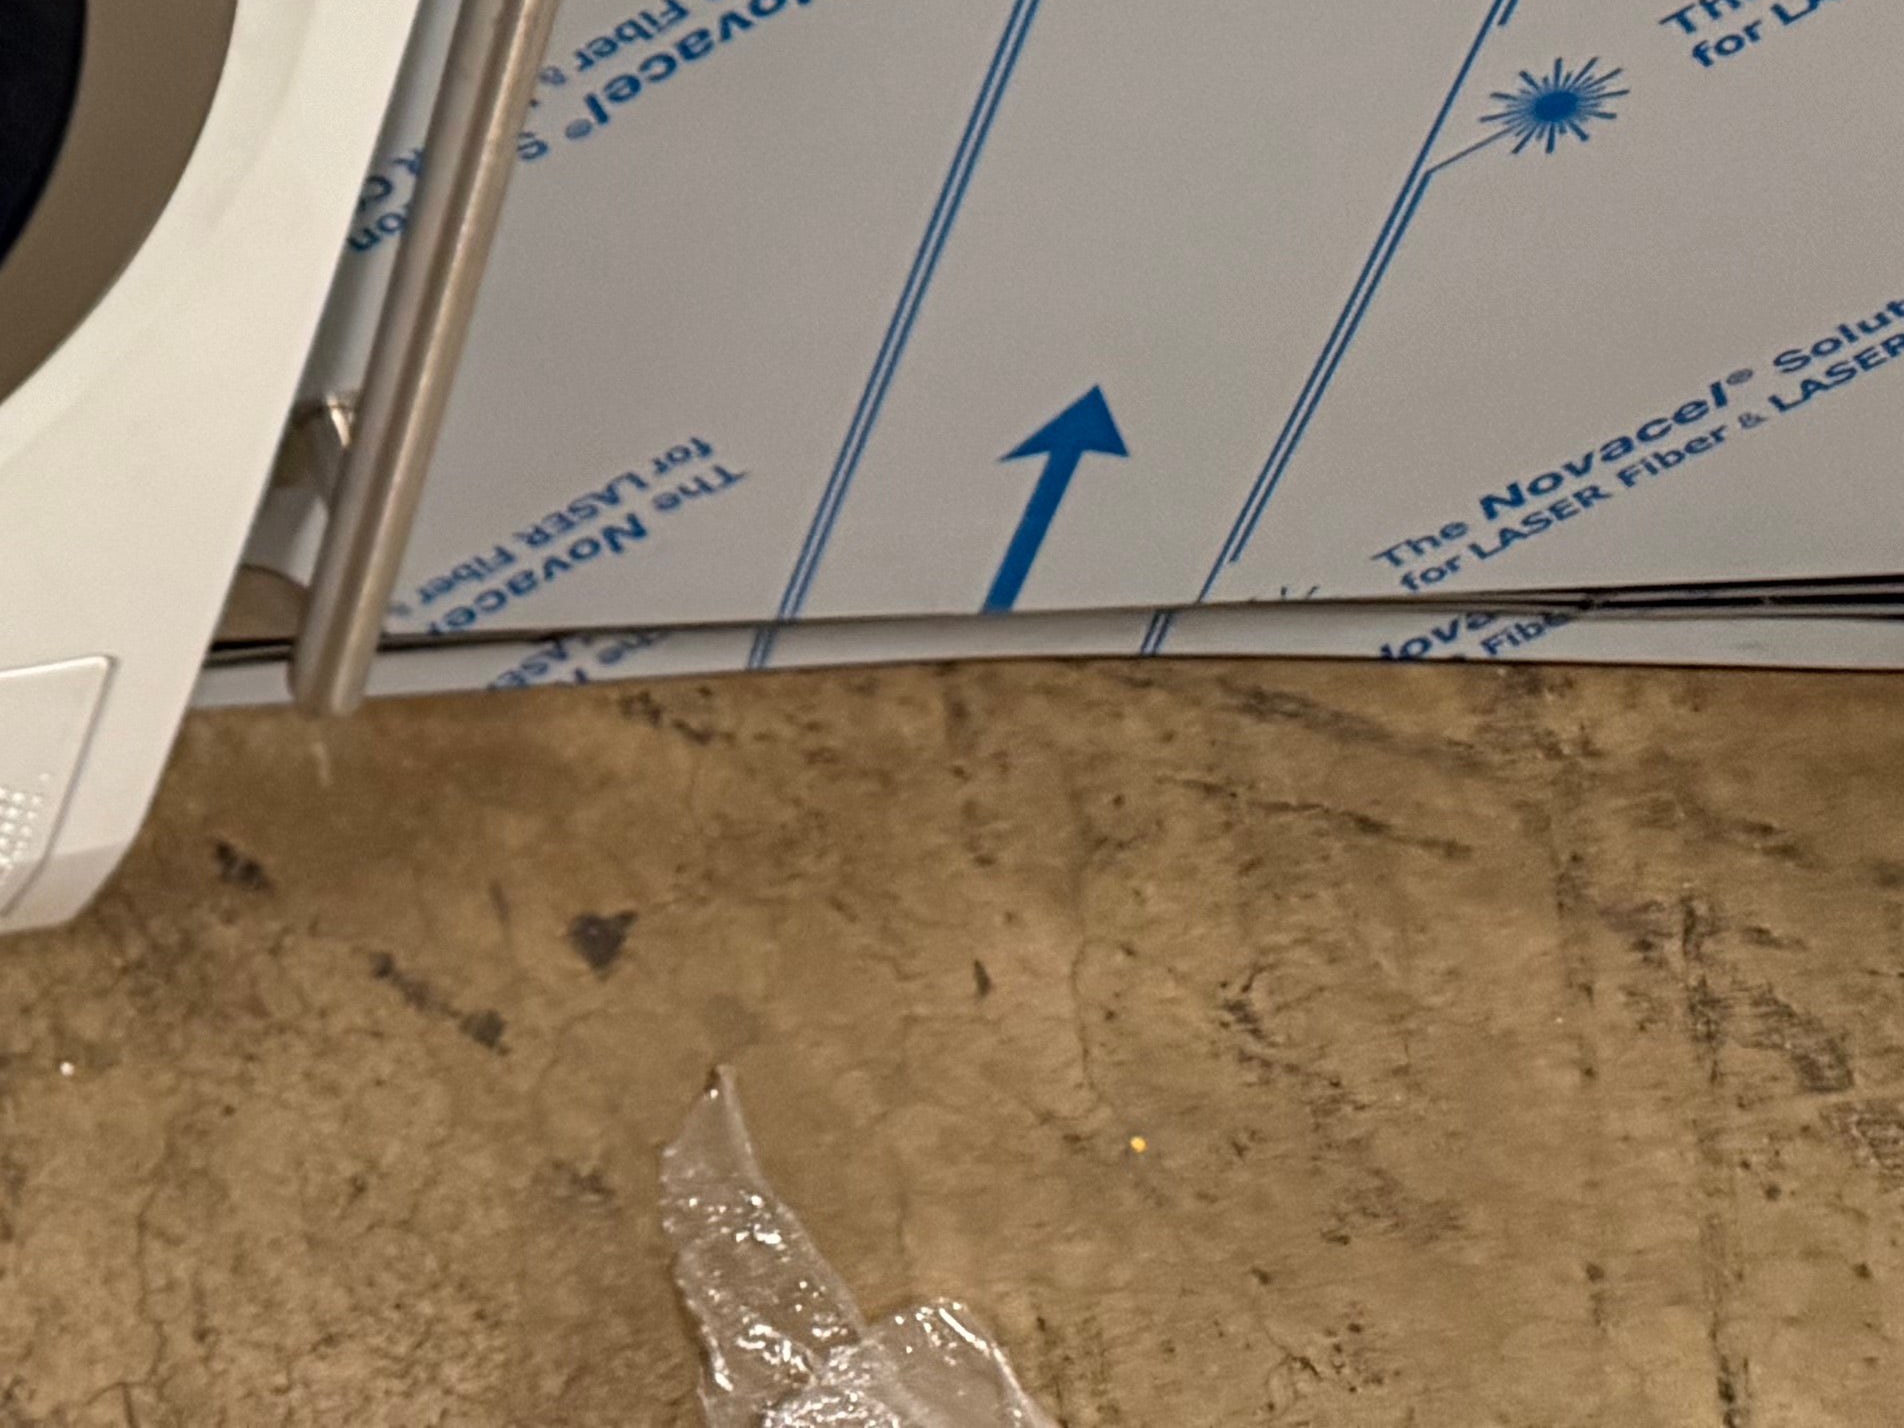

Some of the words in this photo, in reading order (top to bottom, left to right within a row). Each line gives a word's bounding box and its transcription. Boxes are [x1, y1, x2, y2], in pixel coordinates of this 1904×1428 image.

[1692, 19, 1762, 68] for
[652, 437, 713, 476] for
[512, 470, 650, 549] LASER
[653, 464, 749, 512] The
[1398, 555, 1462, 593] for
[1468, 484, 1613, 561] LASER
[1617, 423, 1730, 489] Fiber
[1370, 520, 1469, 569] The
[417, 545, 517, 606] Fiber
